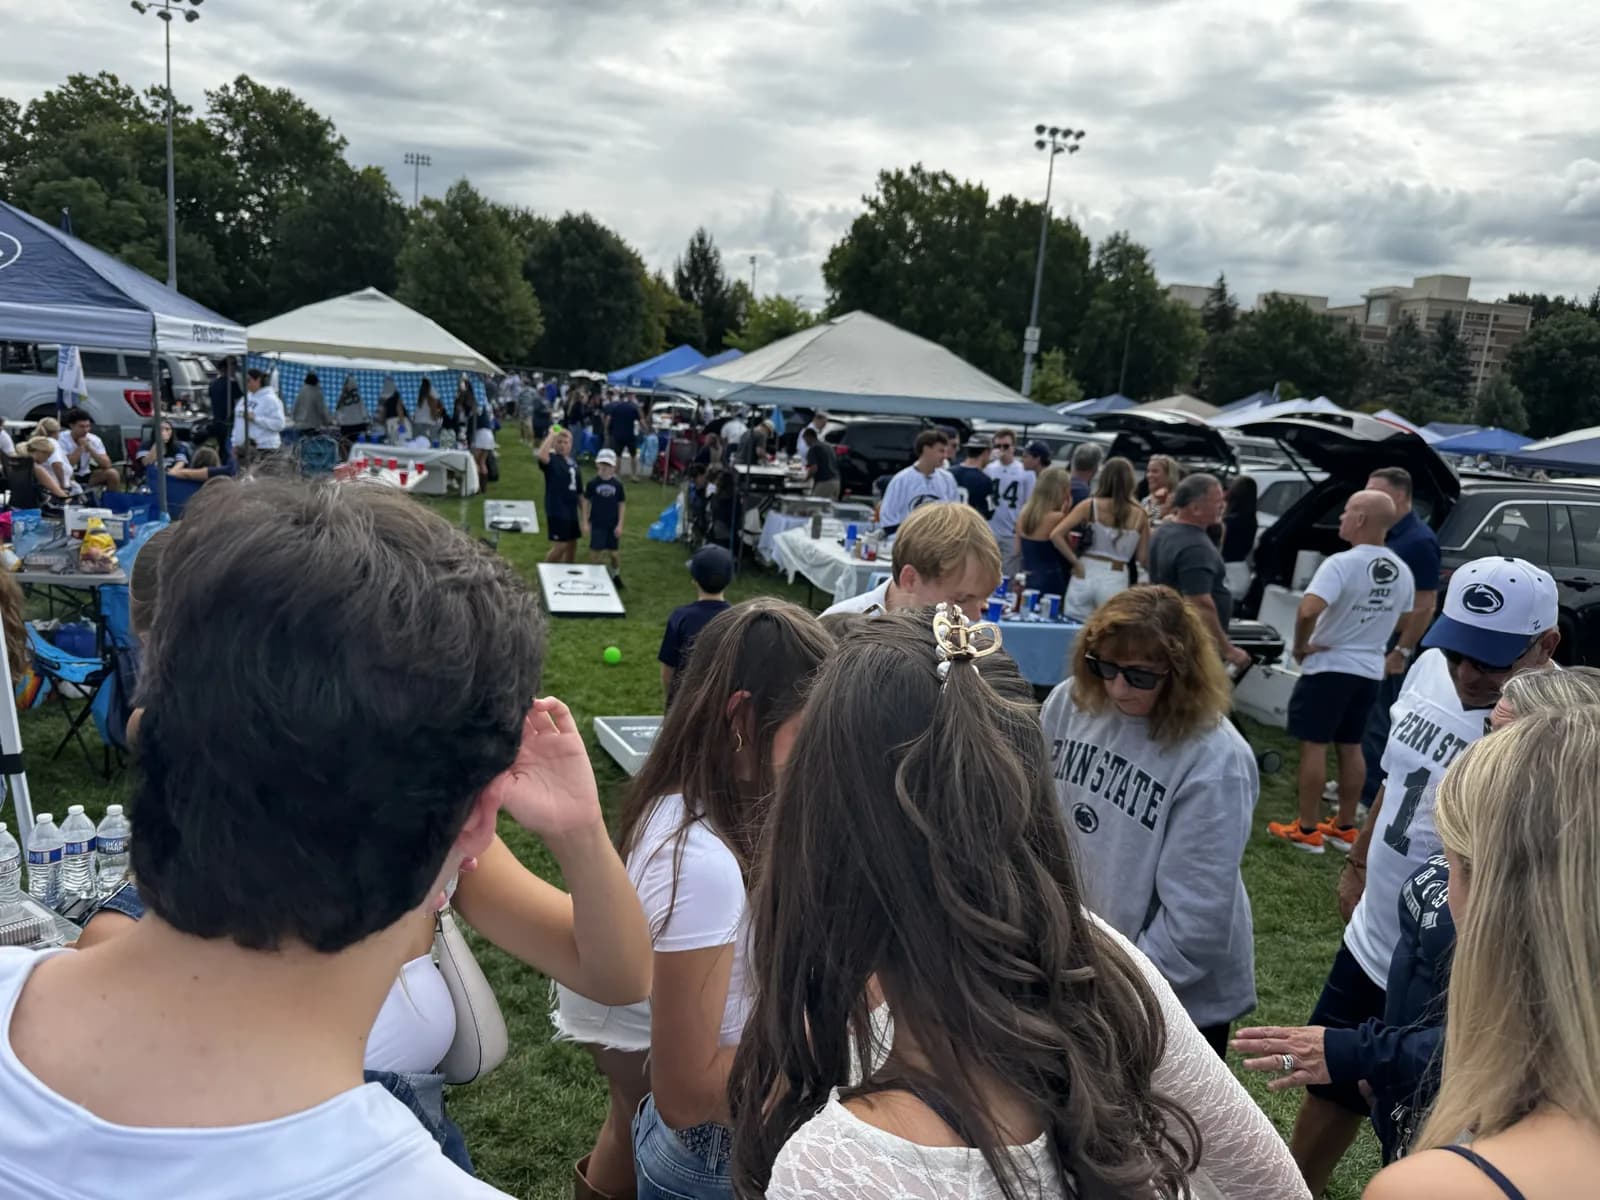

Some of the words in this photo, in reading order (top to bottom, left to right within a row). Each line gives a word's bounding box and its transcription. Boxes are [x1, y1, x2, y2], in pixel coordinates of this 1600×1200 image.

[568, 466, 577, 491] 1
[1391, 711, 1441, 755] PENN
[1090, 750, 1167, 831] STATE
[1383, 766, 1431, 856] 1
